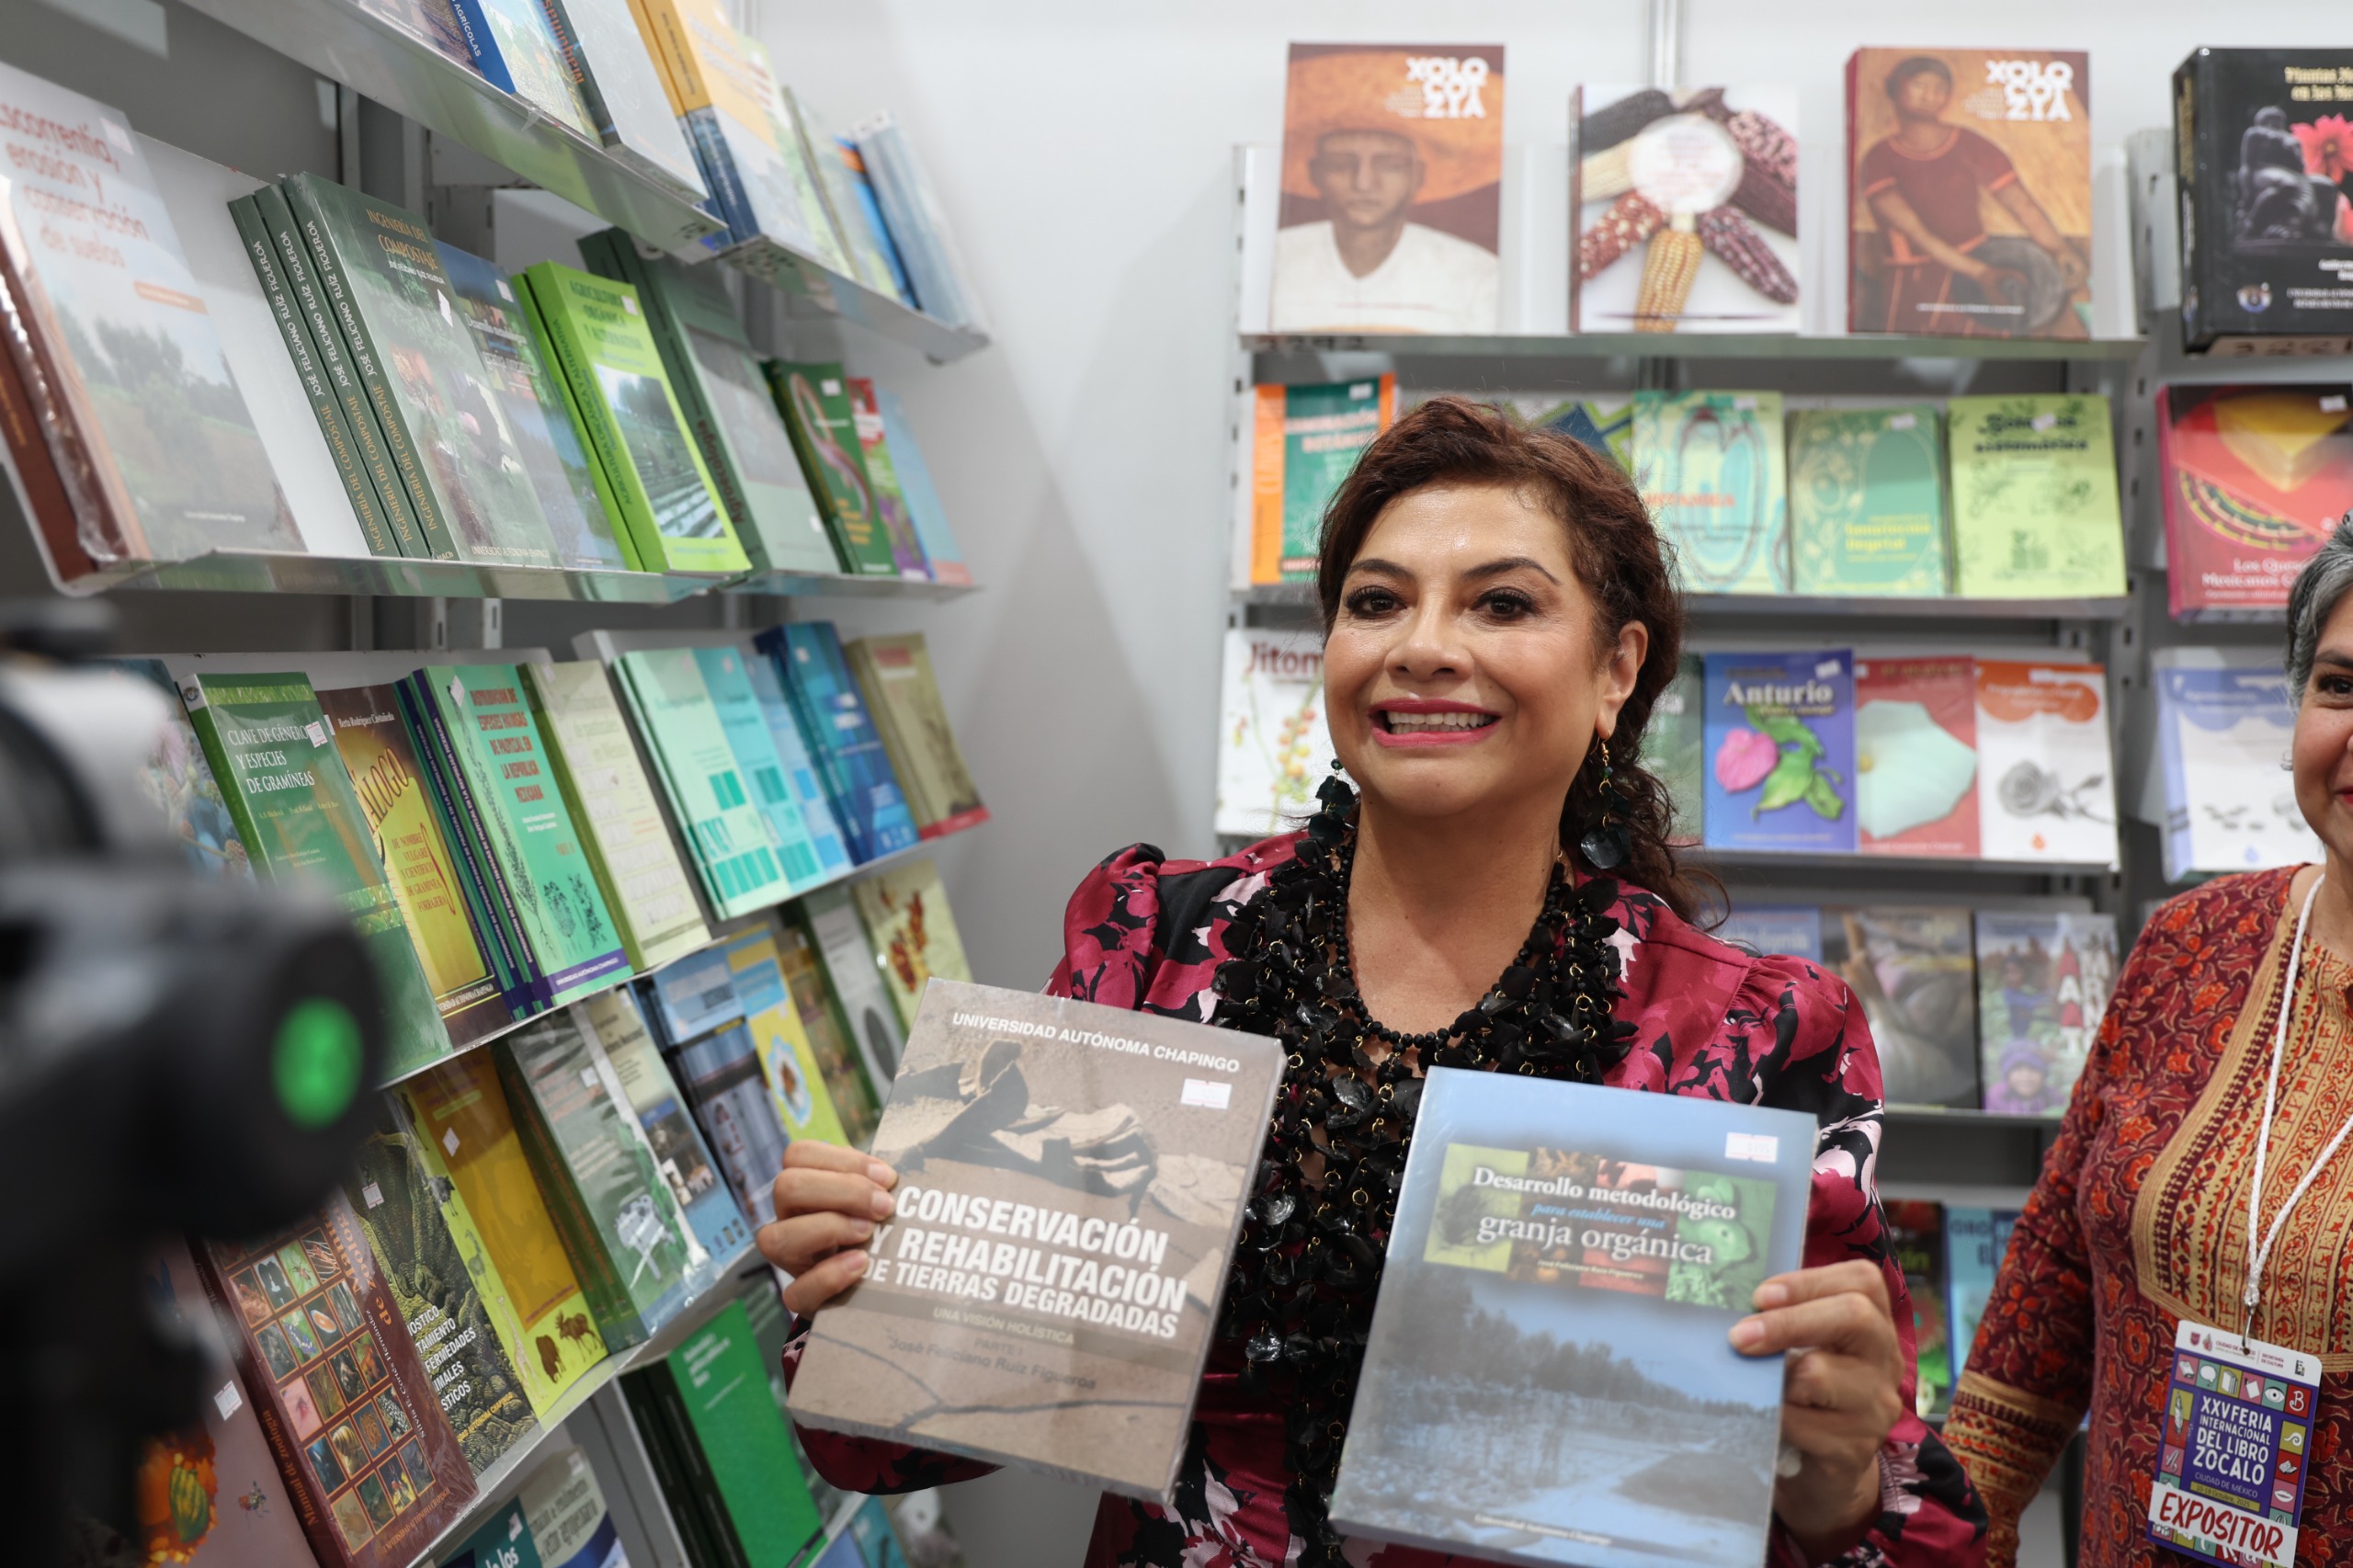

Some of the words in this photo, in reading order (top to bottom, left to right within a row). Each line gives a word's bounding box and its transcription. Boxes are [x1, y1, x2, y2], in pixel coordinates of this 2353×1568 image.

[454, 3, 482, 57] AGRÍCOLAS
[305, 220, 332, 270] FIGUEROA
[378, 234, 438, 271] COMPOSTAJE
[413, 225, 428, 243] DEL
[252, 240, 279, 290] FIGUEROA
[278, 230, 306, 281] FIGUEROA
[313, 311, 339, 361] FELICIANO
[339, 300, 365, 350] FELICIANO
[286, 320, 313, 370] FELICIANO
[333, 363, 351, 389] JOSÉ
[358, 352, 377, 378] JOSÉ
[306, 372, 324, 399] JOSÉ
[347, 392, 381, 460] COMPOSTAJE
[371, 382, 407, 449] COMPOSTAJE
[319, 403, 355, 470] COMPOSTAJE
[373, 460, 388, 482] DEL
[399, 449, 414, 471] DEL
[347, 470, 362, 491] DEL
[380, 482, 412, 542] INGENIERÍA
[406, 471, 438, 530] INGENIERÍA
[354, 491, 386, 551] INGENIERÍA
[228, 724, 257, 746] CLAVE
[256, 726, 272, 744] DE
[235, 754, 246, 770] Y
[245, 750, 288, 769] ESPECIES
[245, 778, 264, 794] DE
[262, 770, 315, 791] GRAMÍNEAS
[952, 1012, 1056, 1040] UNIVERSIDAD
[1058, 1028, 1150, 1056] AUTÓNOMA
[1153, 1045, 1240, 1074] CHAPINGO
[1472, 1166, 1584, 1199] Desarrollo
[1587, 1186, 1736, 1221] metodológico
[895, 1185, 1169, 1266] CONSERVACIÓN
[1530, 1202, 1564, 1218] para
[1567, 1204, 1635, 1225] establecer
[1636, 1214, 1665, 1230] una
[1476, 1214, 1573, 1251] granja
[1580, 1227, 1713, 1266] orgánica
[870, 1222, 894, 1256] Y
[897, 1227, 1188, 1314] REHABILITACIÓN
[377, 1295, 392, 1325] de
[895, 1261, 999, 1301] TIERRAS
[1004, 1281, 1178, 1340] DEGRADADAS
[362, 1307, 392, 1361] Hernández
[934, 1306, 961, 1323] UNA
[963, 1311, 1006, 1332] VISIÓN
[1008, 1321, 1075, 1345] HOLÍSTICA
[889, 1337, 925, 1357] José
[926, 1343, 993, 1369] Feliciano
[1030, 1364, 1097, 1391] Figueroa
[974, 1337, 1016, 1356] PARTE
[387, 1361, 407, 1394] Cortés
[404, 1394, 414, 1407] E.
[2200, 1396, 2231, 1420] XXV
[2231, 1405, 2272, 1433] FERIA
[258, 1408, 291, 1461] zoología
[409, 1408, 427, 1437] Silvia
[2200, 1415, 2270, 1446] INTERNACIONAL
[2197, 1427, 2222, 1450] DEL
[2227, 1437, 2268, 1463] LIBRO
[282, 1460, 297, 1477] de
[2193, 1445, 2265, 1485] ZOCALO
[289, 1477, 319, 1526] Manual
[2195, 1471, 2220, 1486] CIUDAD
[2221, 1478, 2230, 1488] DE
[2232, 1481, 2258, 1499] MÉXICO
[2197, 1484, 2212, 1495] 10-19
[2236, 1496, 2251, 1507] 2025
[2160, 1492, 2284, 1561] EXPOSITOR
[496, 1547, 519, 1566] los
